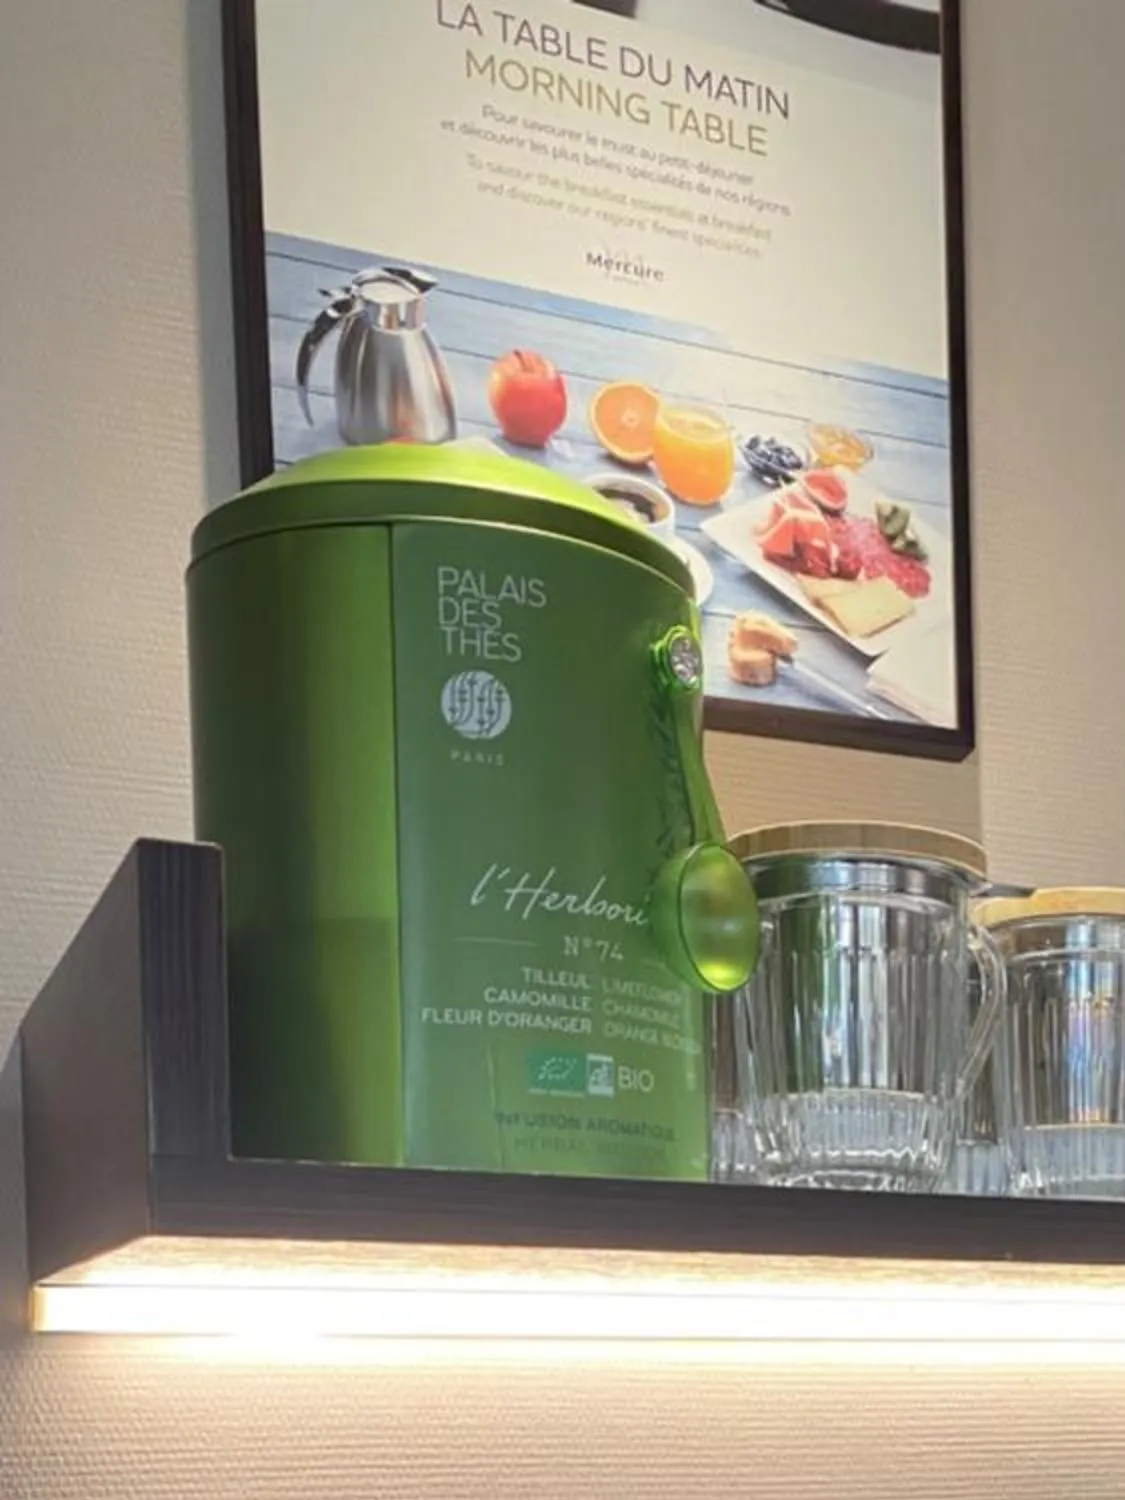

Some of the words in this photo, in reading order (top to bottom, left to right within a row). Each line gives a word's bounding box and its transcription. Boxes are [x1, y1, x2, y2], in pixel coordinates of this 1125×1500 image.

[437, 0, 483, 37] LA
[493, 10, 608, 71] TABLE
[620, 45, 671, 87] DU
[685, 64, 789, 120] MATIN
[465, 48, 650, 125] MORNING
[660, 100, 768, 157] TABLE
[586, 252, 665, 282] Mercure
[437, 565, 548, 609] PALAIS
[438, 595, 502, 631] DES
[450, 749, 505, 767] PARIS
[521, 965, 592, 990] TILLEUL
[483, 985, 593, 1012] CAMOMILLE
[421, 1006, 483, 1025] FLEUR
[488, 1009, 593, 1036] D'ORANGER
[617, 1066, 655, 1092] BIO
